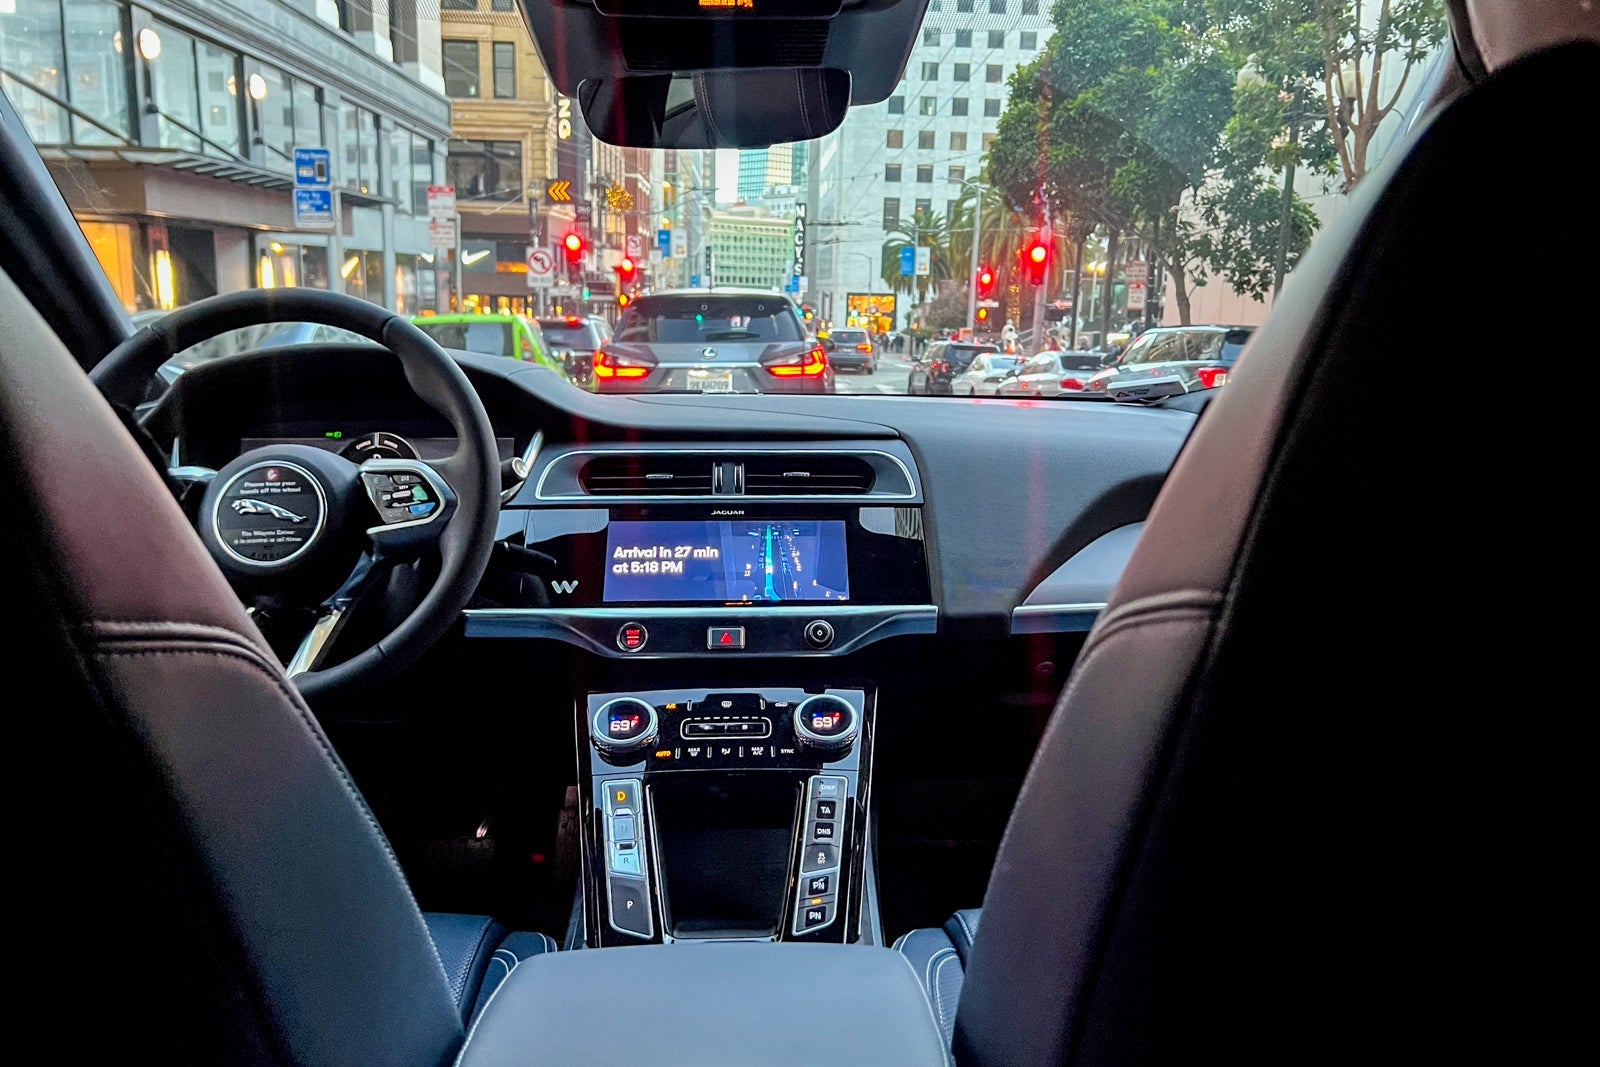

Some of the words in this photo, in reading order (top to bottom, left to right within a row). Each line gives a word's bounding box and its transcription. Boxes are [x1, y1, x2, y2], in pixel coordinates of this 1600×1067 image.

[613, 546, 657, 558] Arrival
[659, 546, 672, 558] in
[674, 546, 692, 558] 27
[693, 546, 719, 558] min
[612, 561, 629, 574] at
[630, 561, 659, 574] 5:18
[661, 561, 683, 573] PM
[616, 790, 626, 802] D
[820, 806, 831, 814] TA
[812, 881, 825, 890] PN
[626, 900, 634, 909] P
[809, 911, 822, 920] PN
